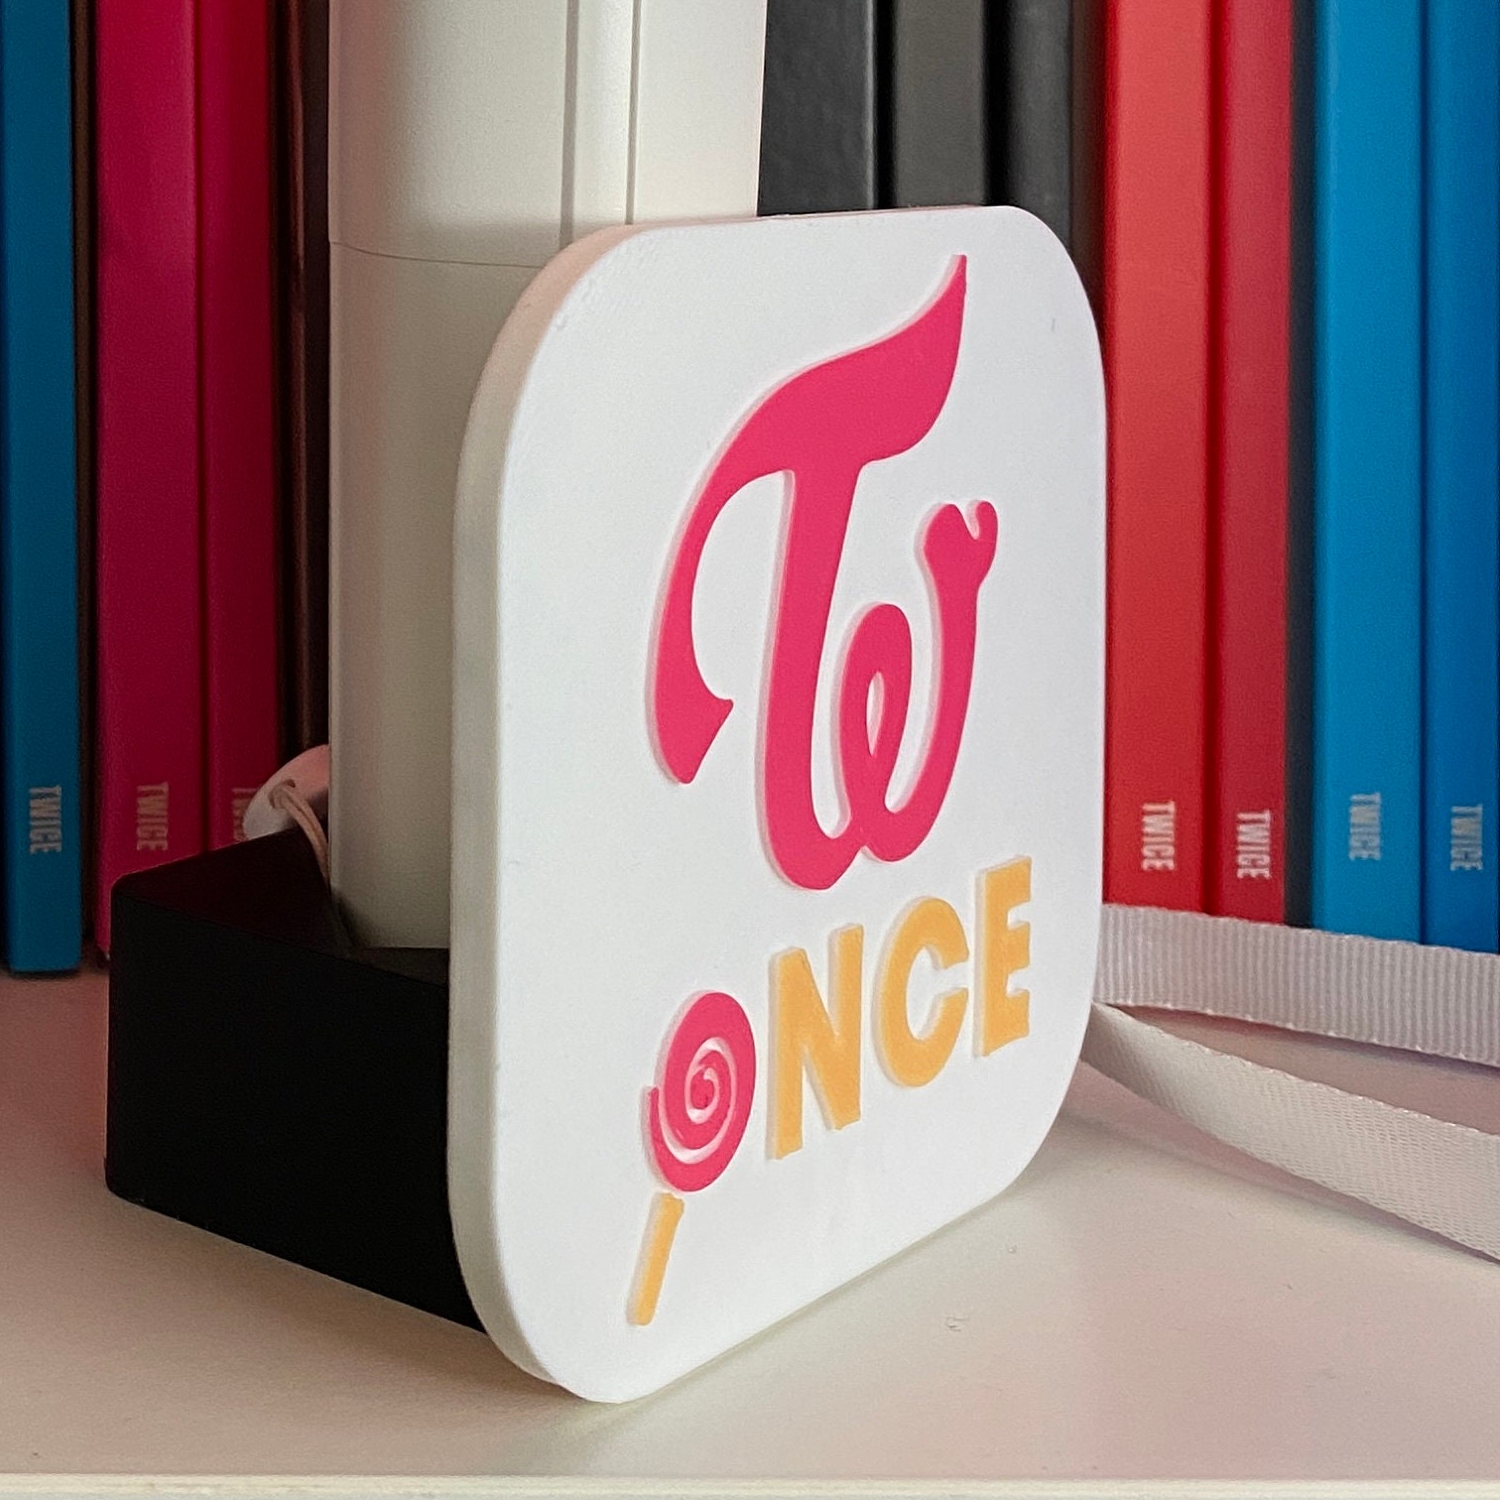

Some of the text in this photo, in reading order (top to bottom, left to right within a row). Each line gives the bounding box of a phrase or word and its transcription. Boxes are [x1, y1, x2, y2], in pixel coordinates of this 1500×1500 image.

[29, 785, 62, 855] TWICE
[136, 781, 169, 851] TWICE
[1141, 801, 1175, 871] TWICE
[1236, 809, 1271, 879] TWICE
[1349, 792, 1381, 861] TWICE
[1451, 804, 1483, 871] TWICE
